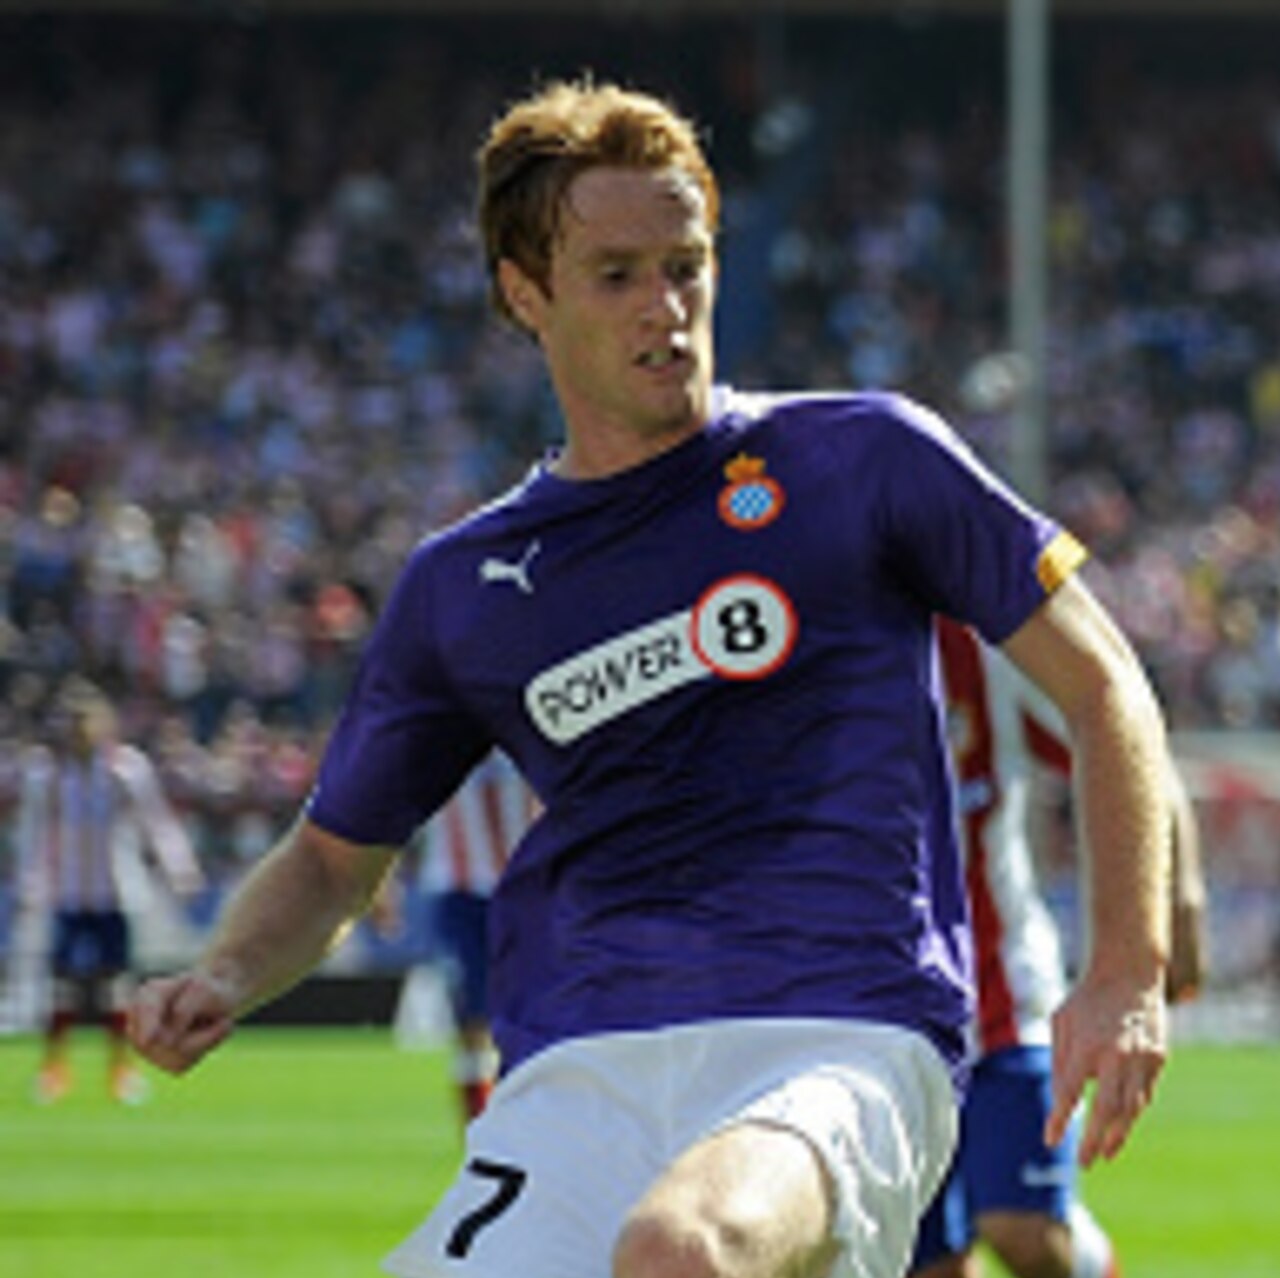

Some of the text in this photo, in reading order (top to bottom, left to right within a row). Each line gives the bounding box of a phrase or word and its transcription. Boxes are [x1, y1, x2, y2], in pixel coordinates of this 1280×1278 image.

[538, 599, 767, 727] POWER 8
[446, 1157, 527, 1259] 7
